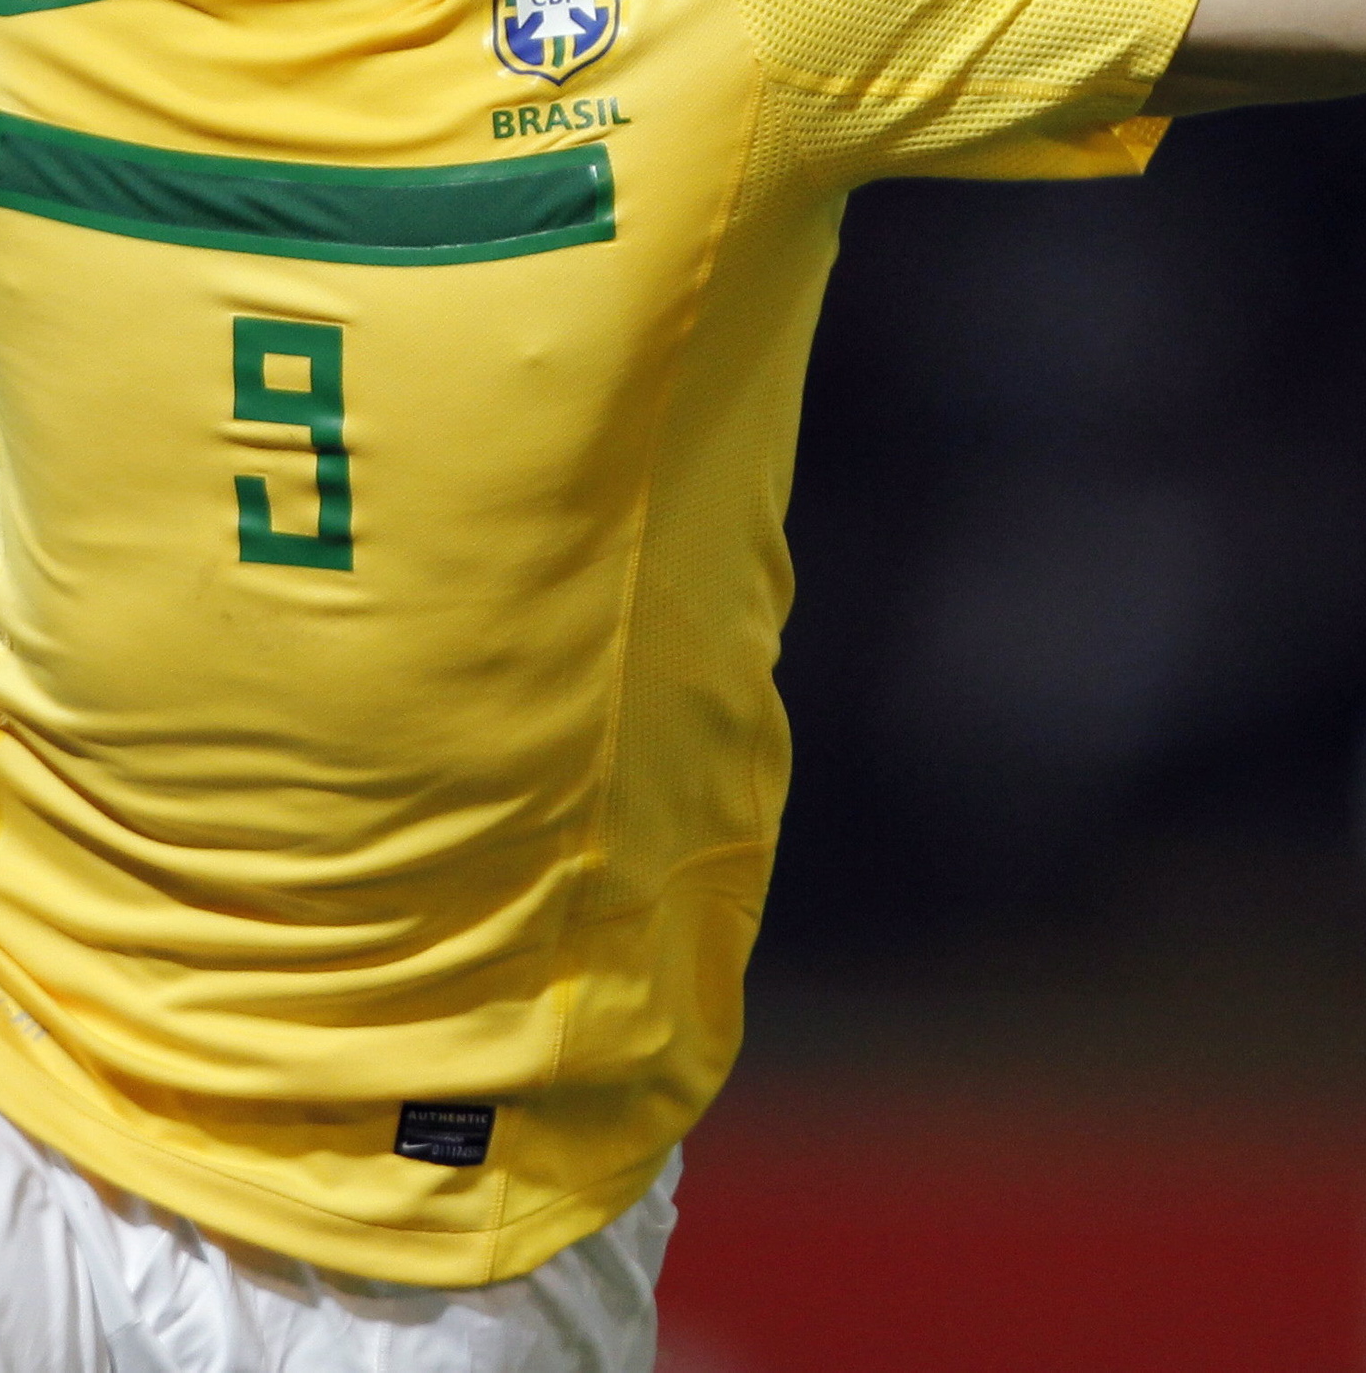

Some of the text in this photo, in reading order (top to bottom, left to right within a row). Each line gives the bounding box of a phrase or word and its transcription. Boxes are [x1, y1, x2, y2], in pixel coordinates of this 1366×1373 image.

[492, 97, 631, 139] BRASIL
[233, 316, 353, 571] 9
[408, 1110, 489, 1124] AUTHENTIC
